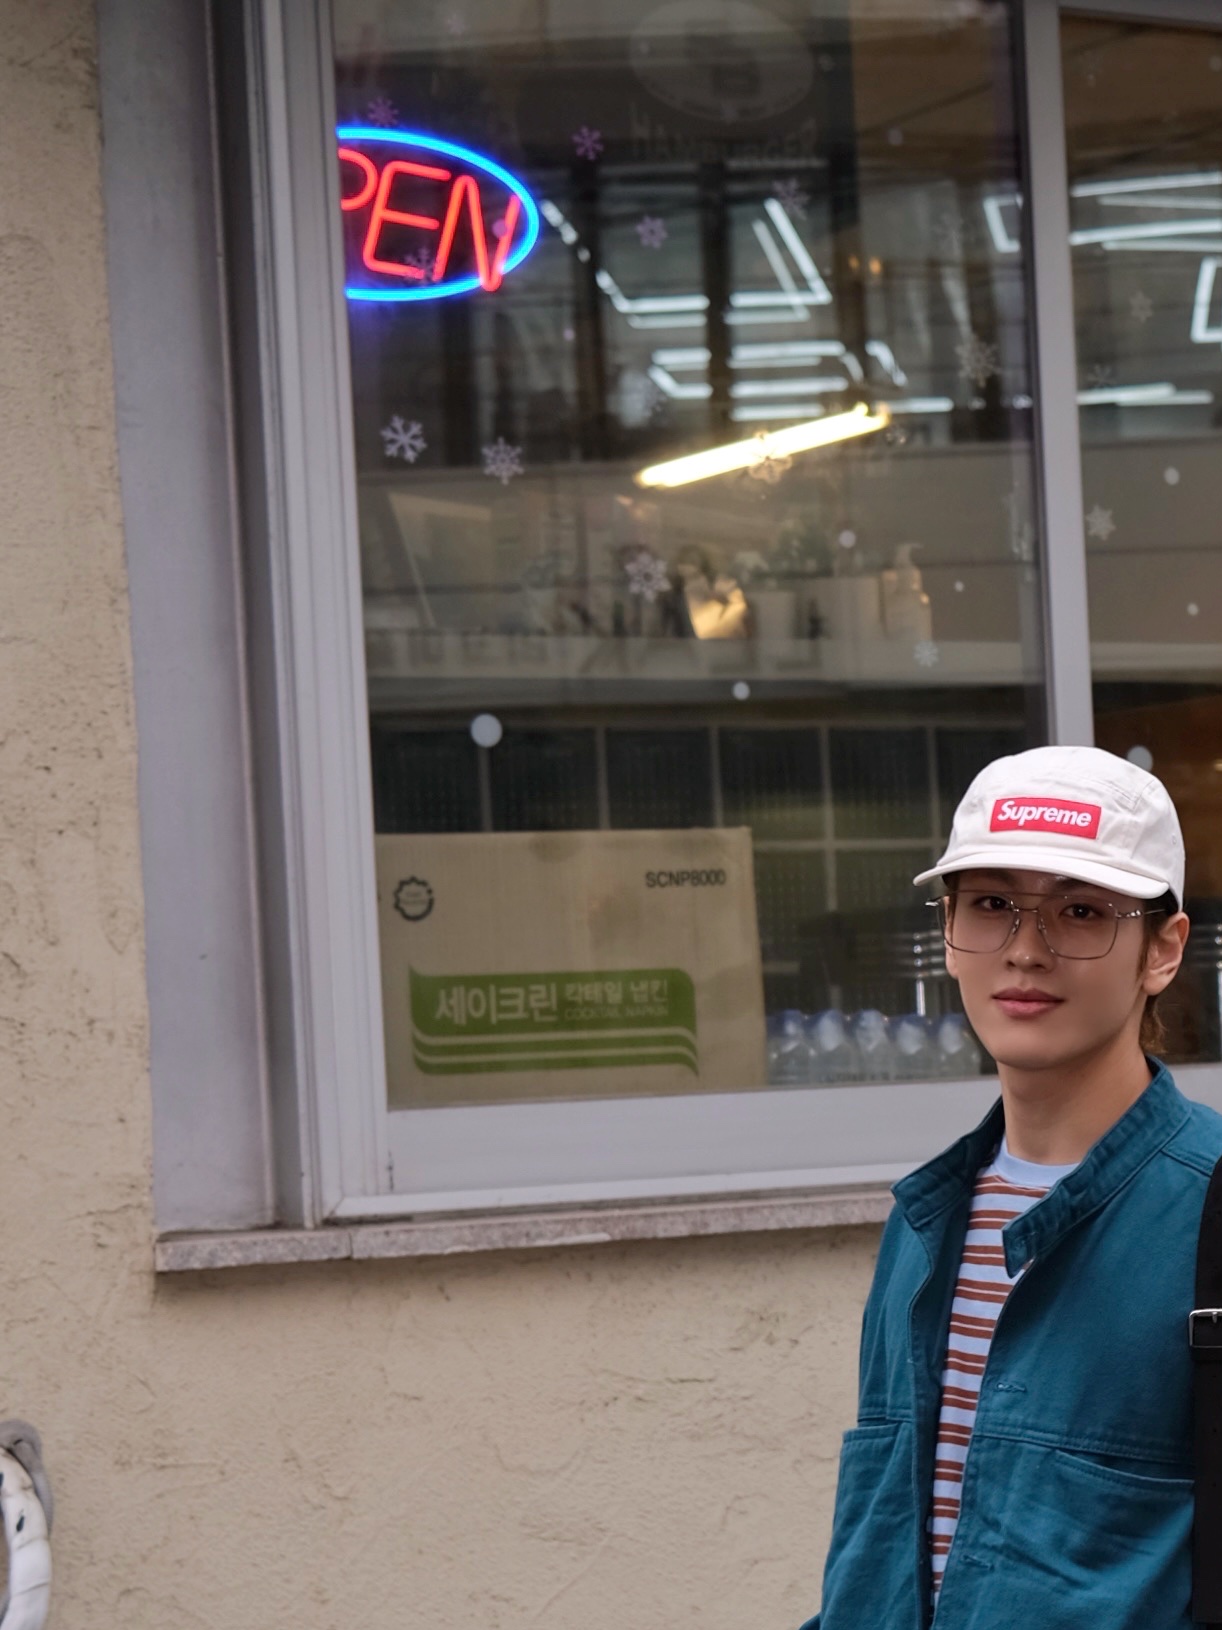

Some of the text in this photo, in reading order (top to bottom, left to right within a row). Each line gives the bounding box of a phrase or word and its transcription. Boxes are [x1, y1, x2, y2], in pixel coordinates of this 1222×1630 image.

[338, 147, 520, 292] PEN
[997, 800, 1092, 827] Supreme
[645, 869, 727, 889] SCNP8000
[434, 984, 558, 1026] 세이크린
